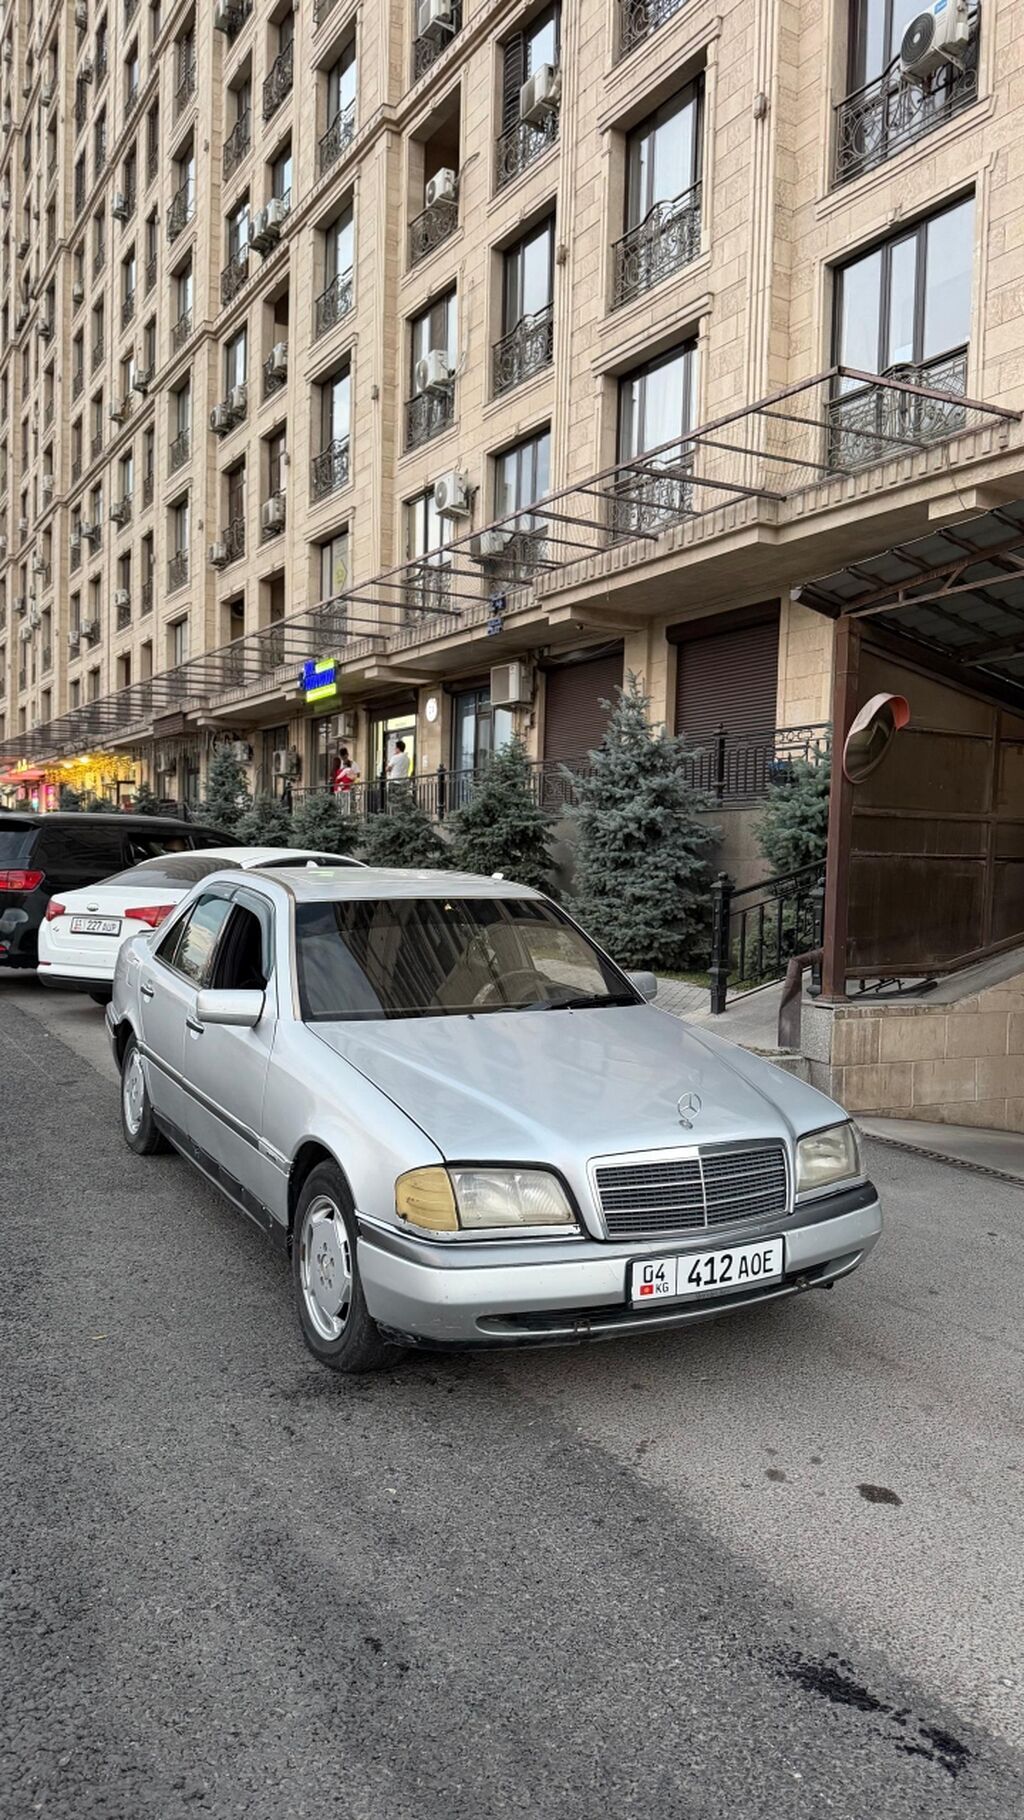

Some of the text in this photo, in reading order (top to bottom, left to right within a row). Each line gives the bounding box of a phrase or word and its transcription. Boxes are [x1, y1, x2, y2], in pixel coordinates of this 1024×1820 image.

[86, 920, 102, 931] 227
[643, 1249, 774, 1287] 04 412 AOE
[655, 1281, 669, 1294] KG
